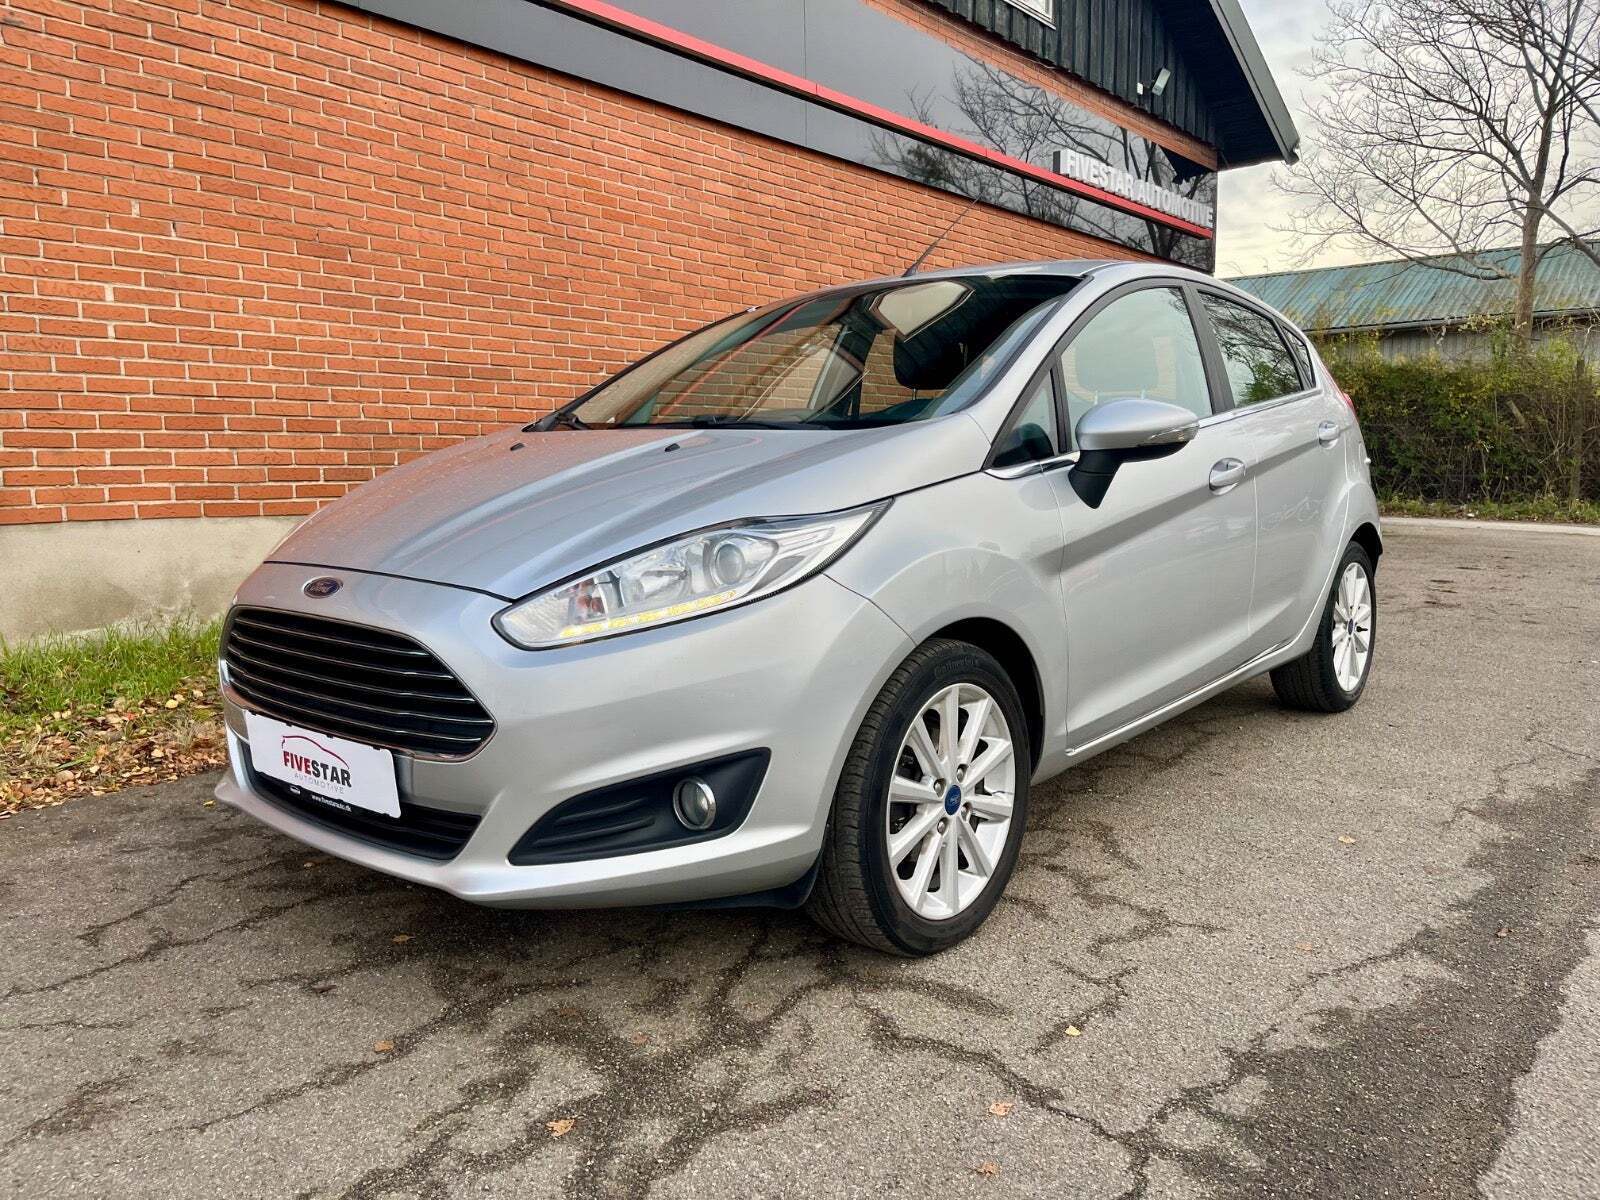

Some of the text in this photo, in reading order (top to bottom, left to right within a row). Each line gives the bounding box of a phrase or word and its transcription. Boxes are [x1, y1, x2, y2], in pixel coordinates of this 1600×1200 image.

[1060, 149, 1214, 229] FIVESTAR AUTOMOTIVE
[283, 750, 352, 788] FIVESTAR
[294, 772, 345, 795] AUTOMOTIVE
